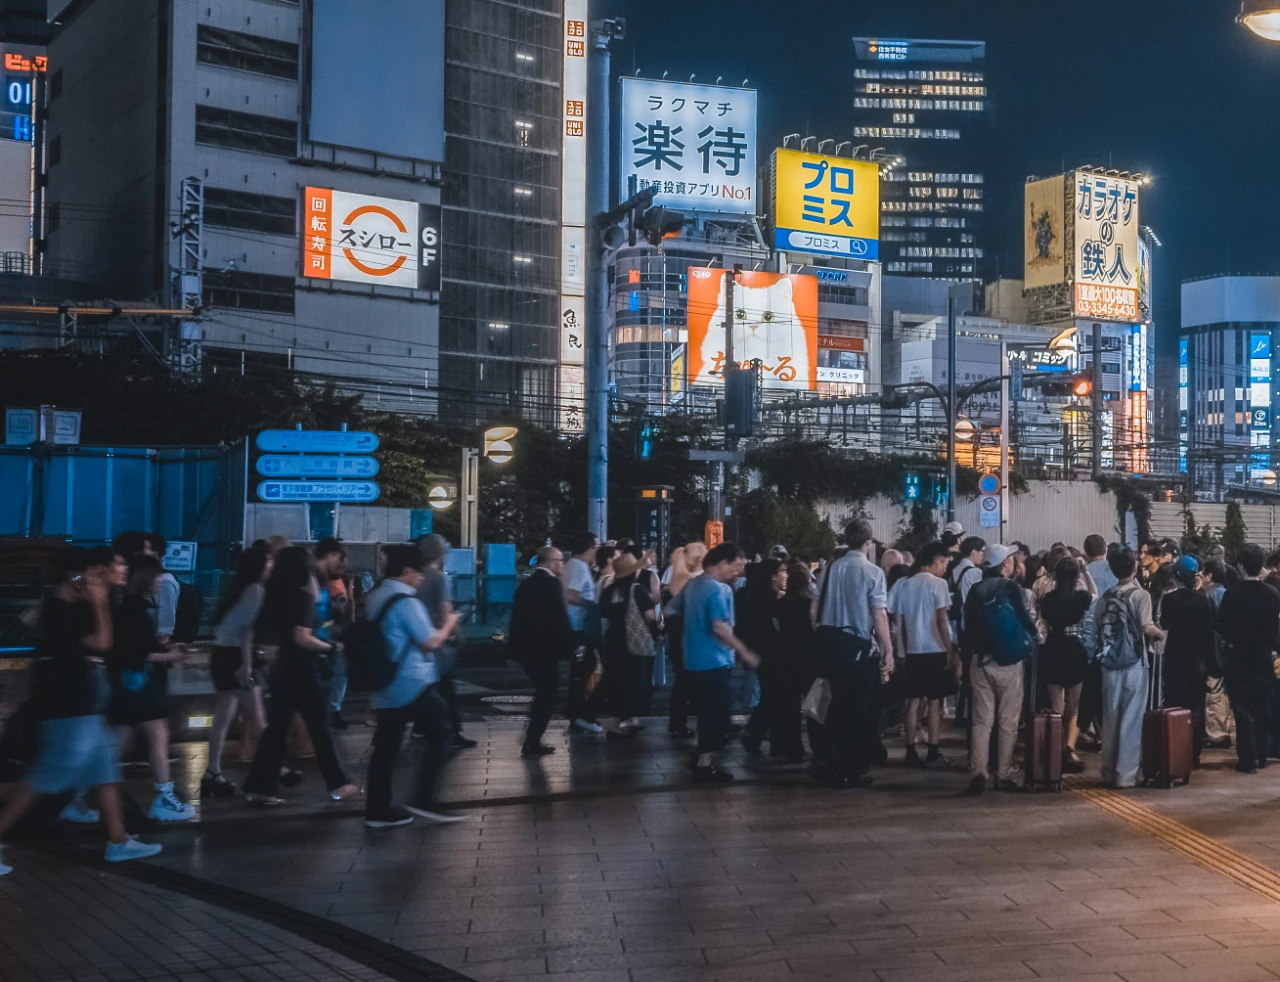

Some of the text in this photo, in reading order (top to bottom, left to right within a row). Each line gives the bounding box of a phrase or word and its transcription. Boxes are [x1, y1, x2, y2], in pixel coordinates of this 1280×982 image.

[647, 95, 733, 117] ラクマチ
[631, 119, 748, 177] 楽待
[637, 178, 752, 201] 動産投資アプリ No.1
[801, 160, 855, 195] プロ
[801, 195, 854, 228] ミス
[1076, 174, 1137, 226] カラオケ
[311, 196, 327, 271] 回転寿司
[338, 228, 412, 250] スシロー
[421, 226, 437, 267] 6F
[804, 236, 840, 250] プロミス
[1100, 218, 1115, 247] の
[1080, 239, 1132, 286] 鉄人
[1078, 300, 1136, 317] 03-3345-6430
[563, 308, 583, 349] 魚民
[829, 371, 860, 380] クリニック
